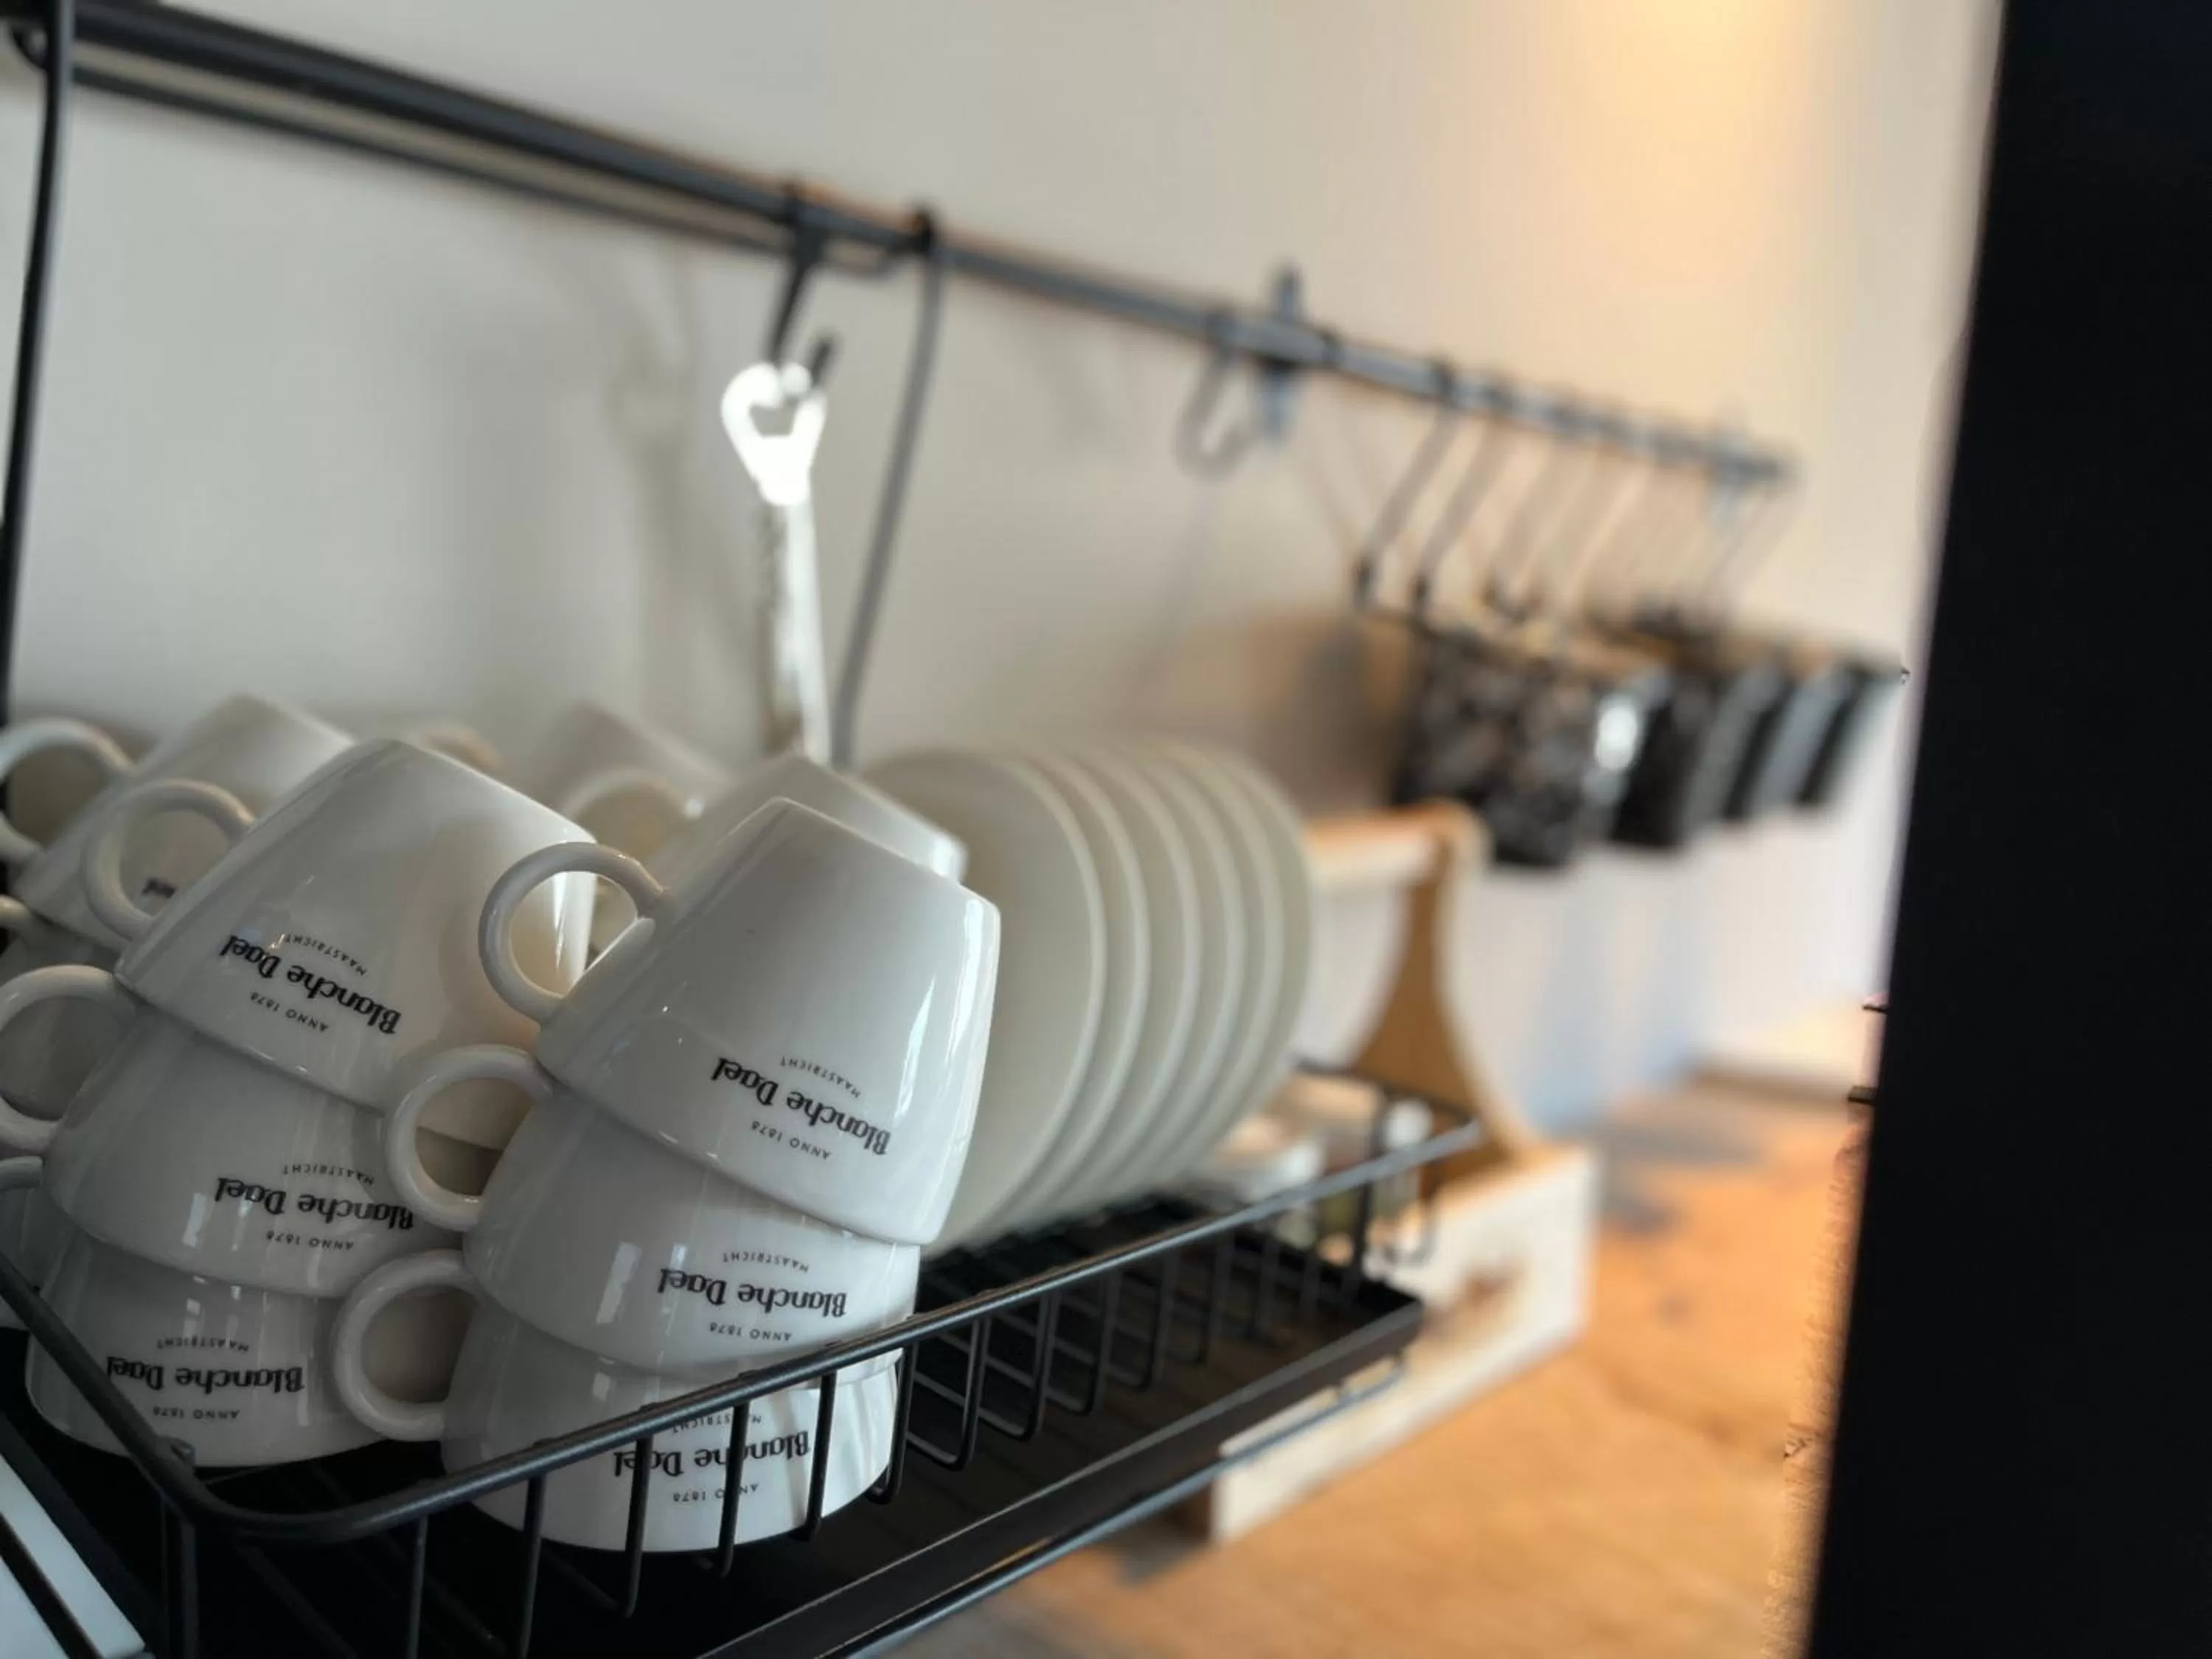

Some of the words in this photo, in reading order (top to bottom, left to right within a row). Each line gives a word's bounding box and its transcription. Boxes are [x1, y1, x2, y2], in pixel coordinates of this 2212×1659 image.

[219, 934, 282, 979] Dael
[285, 933, 367, 977] MAASTRICHT
[249, 992, 280, 1012] 1878
[286, 964, 402, 1034] Blanche
[285, 1008, 330, 1032] ANNO
[710, 1057, 779, 1106] Dael
[779, 1055, 862, 1098] MAASTRICHT
[751, 1120, 784, 1142] 1878
[787, 1091, 891, 1155] Blanche
[789, 1137, 832, 1160] ANNO
[282, 1164, 375, 1185] MAASTRICHT
[215, 1178, 287, 1215] Dael
[297, 1193, 414, 1230] Blanche
[265, 1229, 300, 1245] 1878
[307, 1237, 355, 1251] ANNO
[723, 1251, 809, 1273] MAASTRICHT
[657, 1268, 728, 1306] Dael
[737, 1283, 847, 1318] Blanche
[709, 1322, 742, 1337] 1878
[748, 1329, 793, 1342] ANNO
[156, 1335, 250, 1352] MAASTRICHT
[106, 1356, 164, 1391] Dael
[174, 1366, 305, 1394] Blanche
[192, 1409, 240, 1419] ANNO
[672, 1413, 762, 1433] MSTRICHT
[694, 1430, 810, 1467] Blanhe
[672, 1488, 706, 1502] 1878
[713, 1483, 759, 1500] ANO
